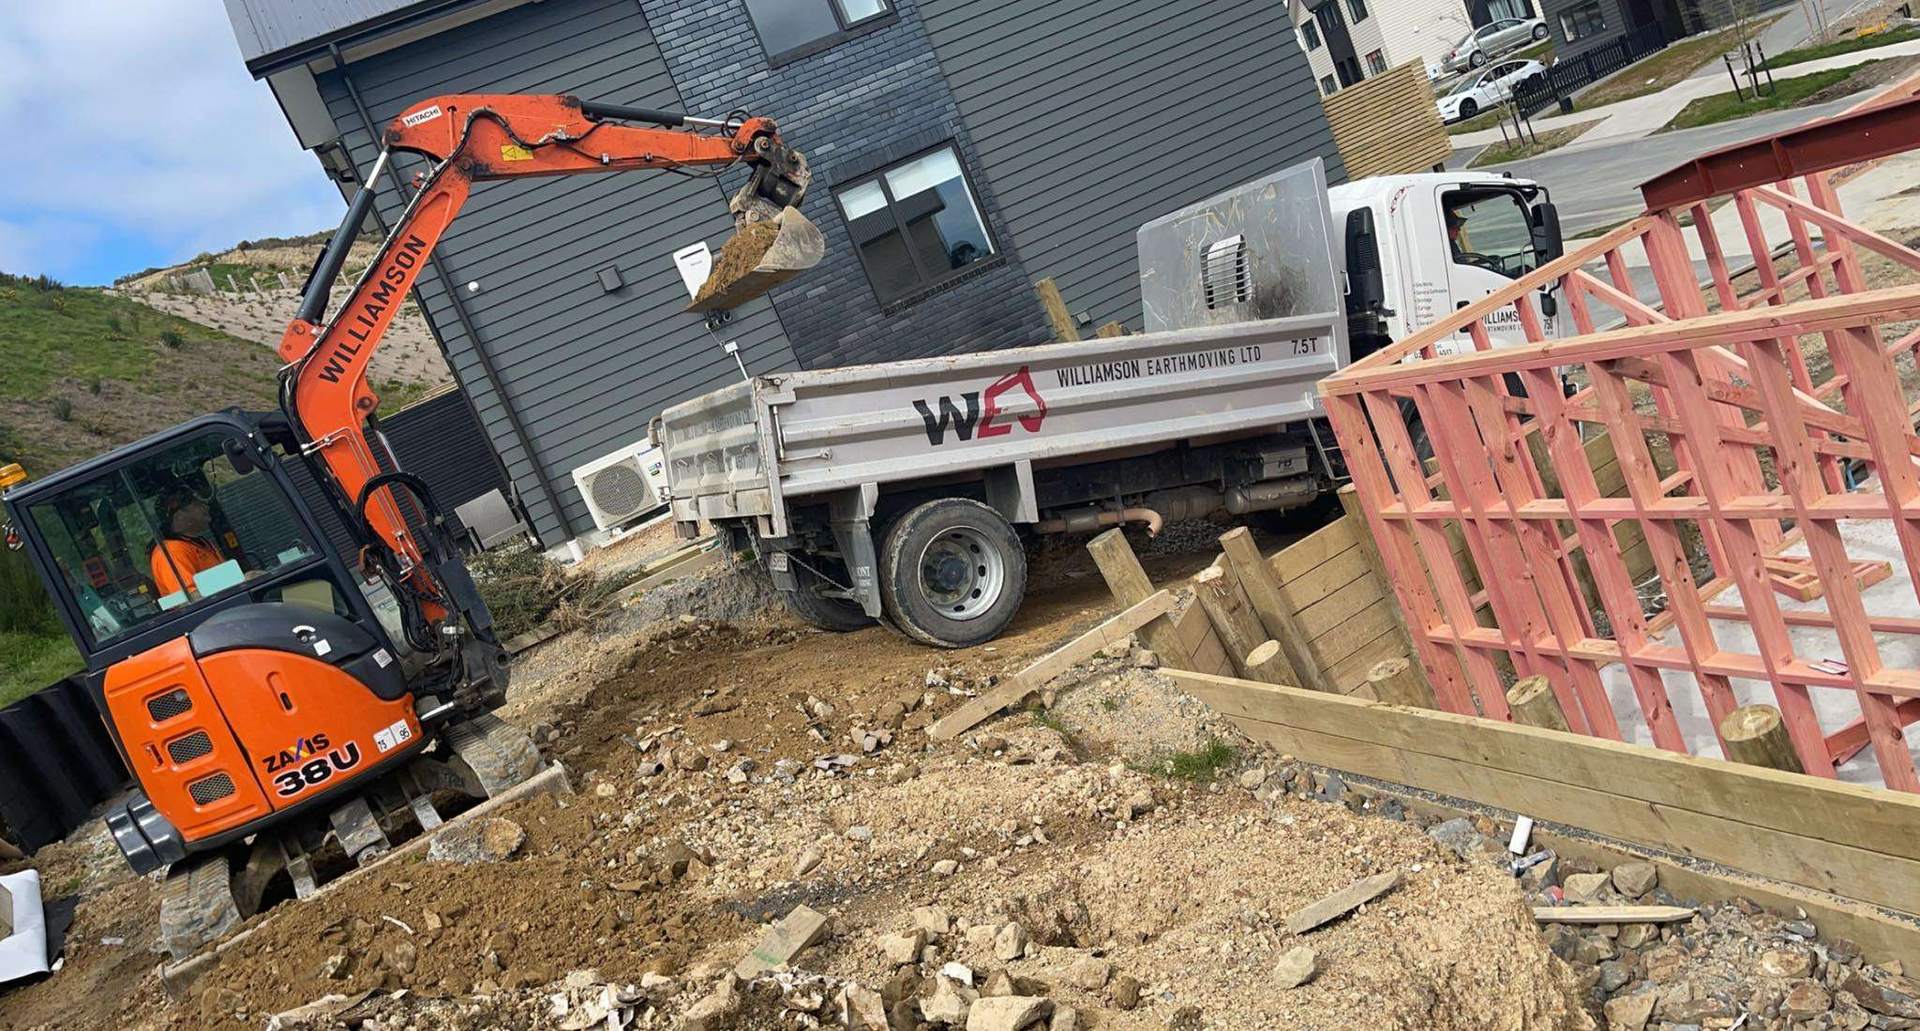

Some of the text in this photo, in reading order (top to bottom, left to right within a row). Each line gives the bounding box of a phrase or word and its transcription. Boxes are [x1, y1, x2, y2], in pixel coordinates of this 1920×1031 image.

[406, 109, 439, 125] HITACHI
[318, 234, 426, 384] WILLIAMSON
[1291, 337, 1317, 355] 7.5T
[1056, 346, 1261, 387] WILLIAMSON EARTHMOVING LTD
[263, 733, 330, 773] ZAXIS
[273, 740, 361, 797] 38U
